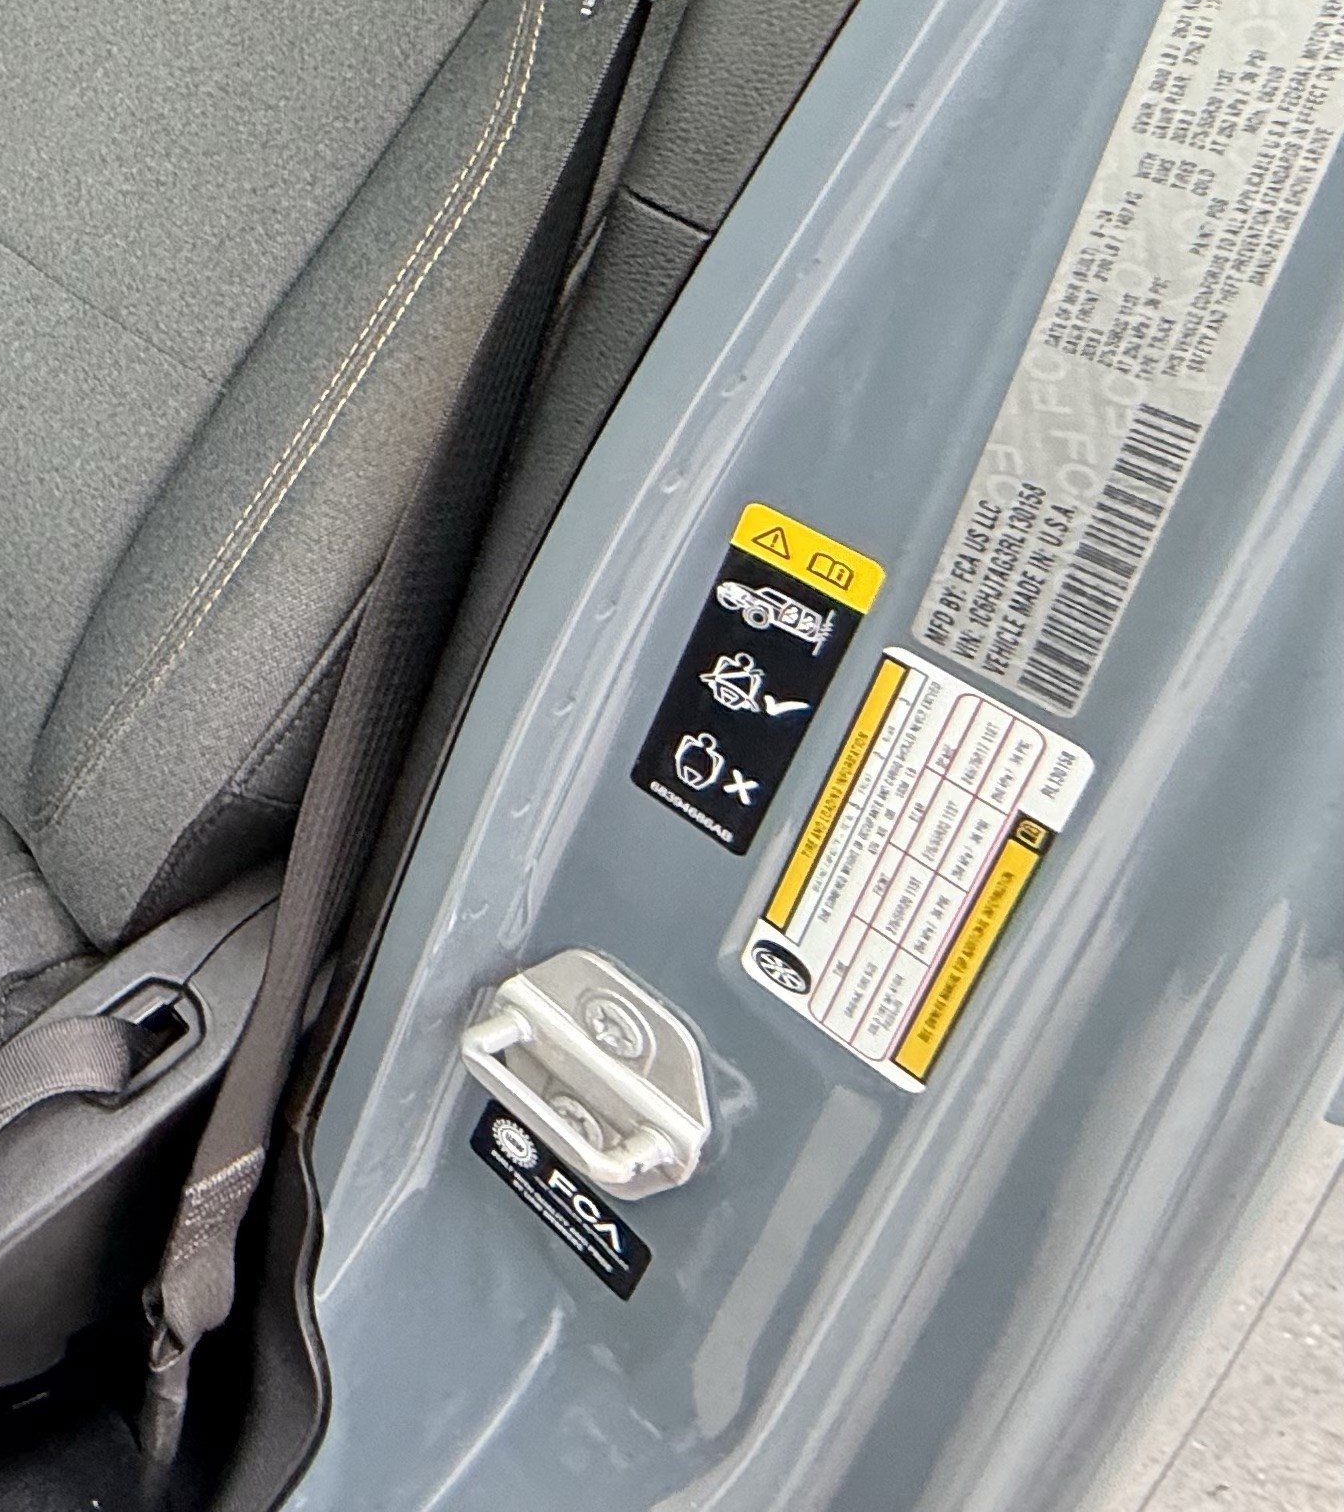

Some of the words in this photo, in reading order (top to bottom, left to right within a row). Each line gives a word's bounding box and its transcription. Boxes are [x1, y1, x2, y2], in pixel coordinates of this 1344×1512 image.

[1297, 20, 1335, 62] MOTOR
[1275, 61, 1317, 114] FEDERAL
[1313, 62, 1341, 81] ON
[1293, 82, 1332, 125] EFFECT
[1288, 125, 1311, 140] IN
[1299, 126, 1336, 165] ABOVE
[1130, 150, 1159, 180] WITH
[1149, 156, 1177, 186] RIMS
[1168, 158, 1198, 191] TIRES
[1188, 166, 1218, 198] COLD
[1231, 150, 1278, 215] APPLICABLE
[1257, 140, 1306, 207] STANDARDS
[1280, 163, 1319, 207] SHOWN
[1214, 235, 1239, 253] TO
[1222, 214, 1248, 236] ALL
[1228, 206, 1276, 273] PREVENTION
[1243, 206, 1299, 286] MANUFACTURE
[1189, 252, 1232, 311] CONFORMS
[1213, 273, 1245, 309] THEFT
[1169, 309, 1206, 355] VEHICLE
[1202, 308, 1230, 334] AND
[1158, 352, 1186, 379] THIS
[1183, 331, 1219, 374] SAFETY
[970, 496, 1003, 531] LLC
[1035, 496, 1079, 549] U.S.A.
[960, 525, 991, 554] US
[948, 548, 981, 584] FCA
[1024, 544, 1057, 574] IN:
[937, 581, 968, 613] BY:
[1005, 568, 1047, 618] MADE
[923, 608, 956, 647] MFD
[950, 625, 985, 663] VIN:
[979, 613, 1027, 679] VEHICLE
[544, 1167, 629, 1255] FCA
